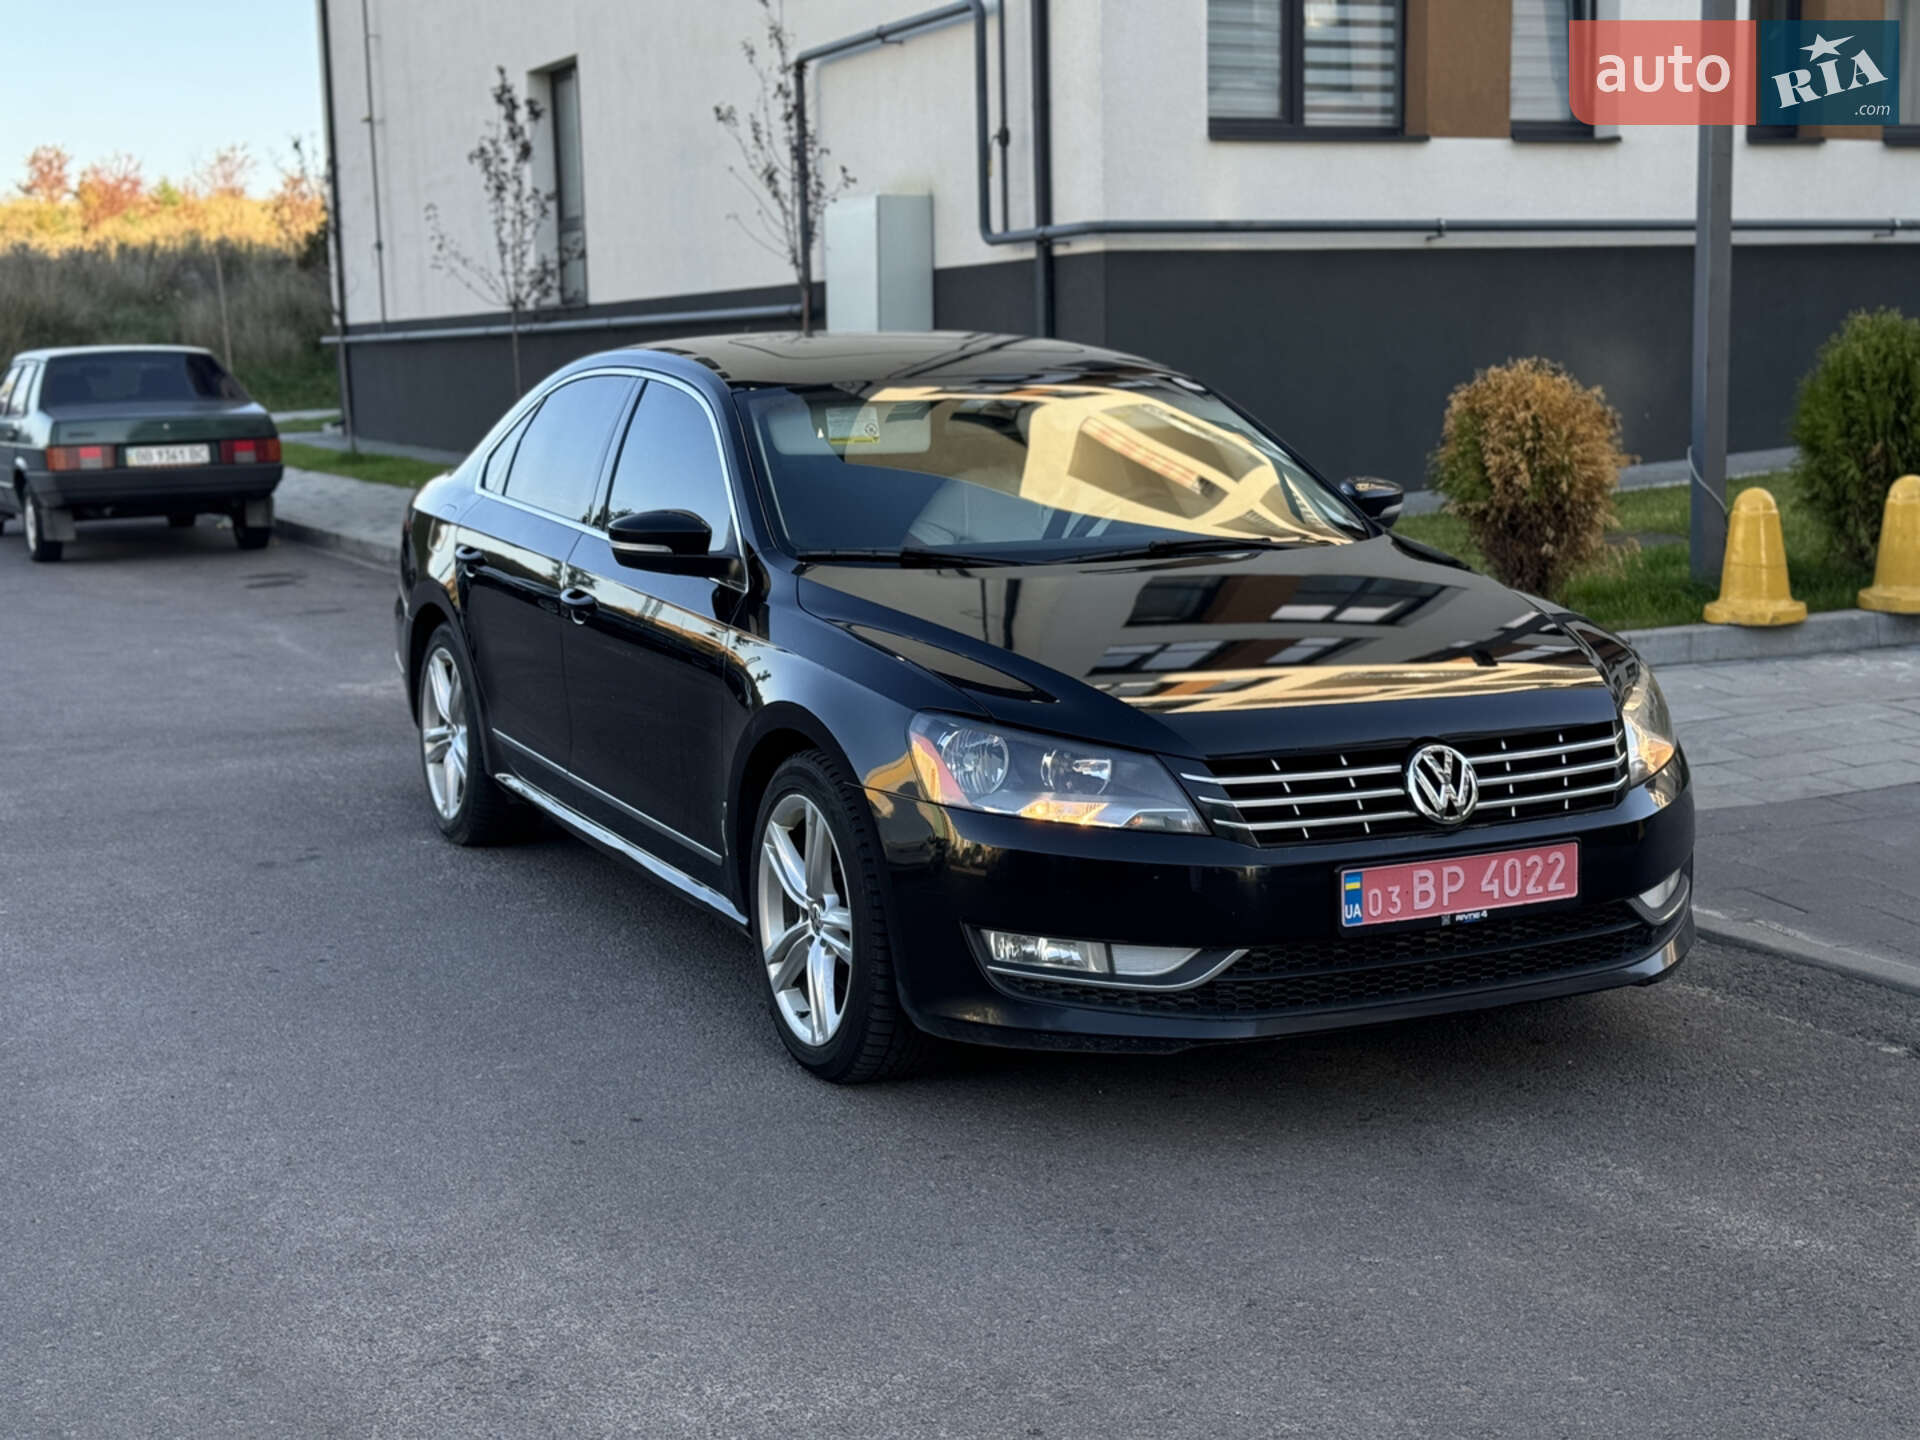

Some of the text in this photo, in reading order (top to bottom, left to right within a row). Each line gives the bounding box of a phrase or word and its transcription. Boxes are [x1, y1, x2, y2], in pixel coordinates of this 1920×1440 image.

[1368, 851, 1566, 917] 03 BP 4022
[1345, 903, 1362, 919] UA
